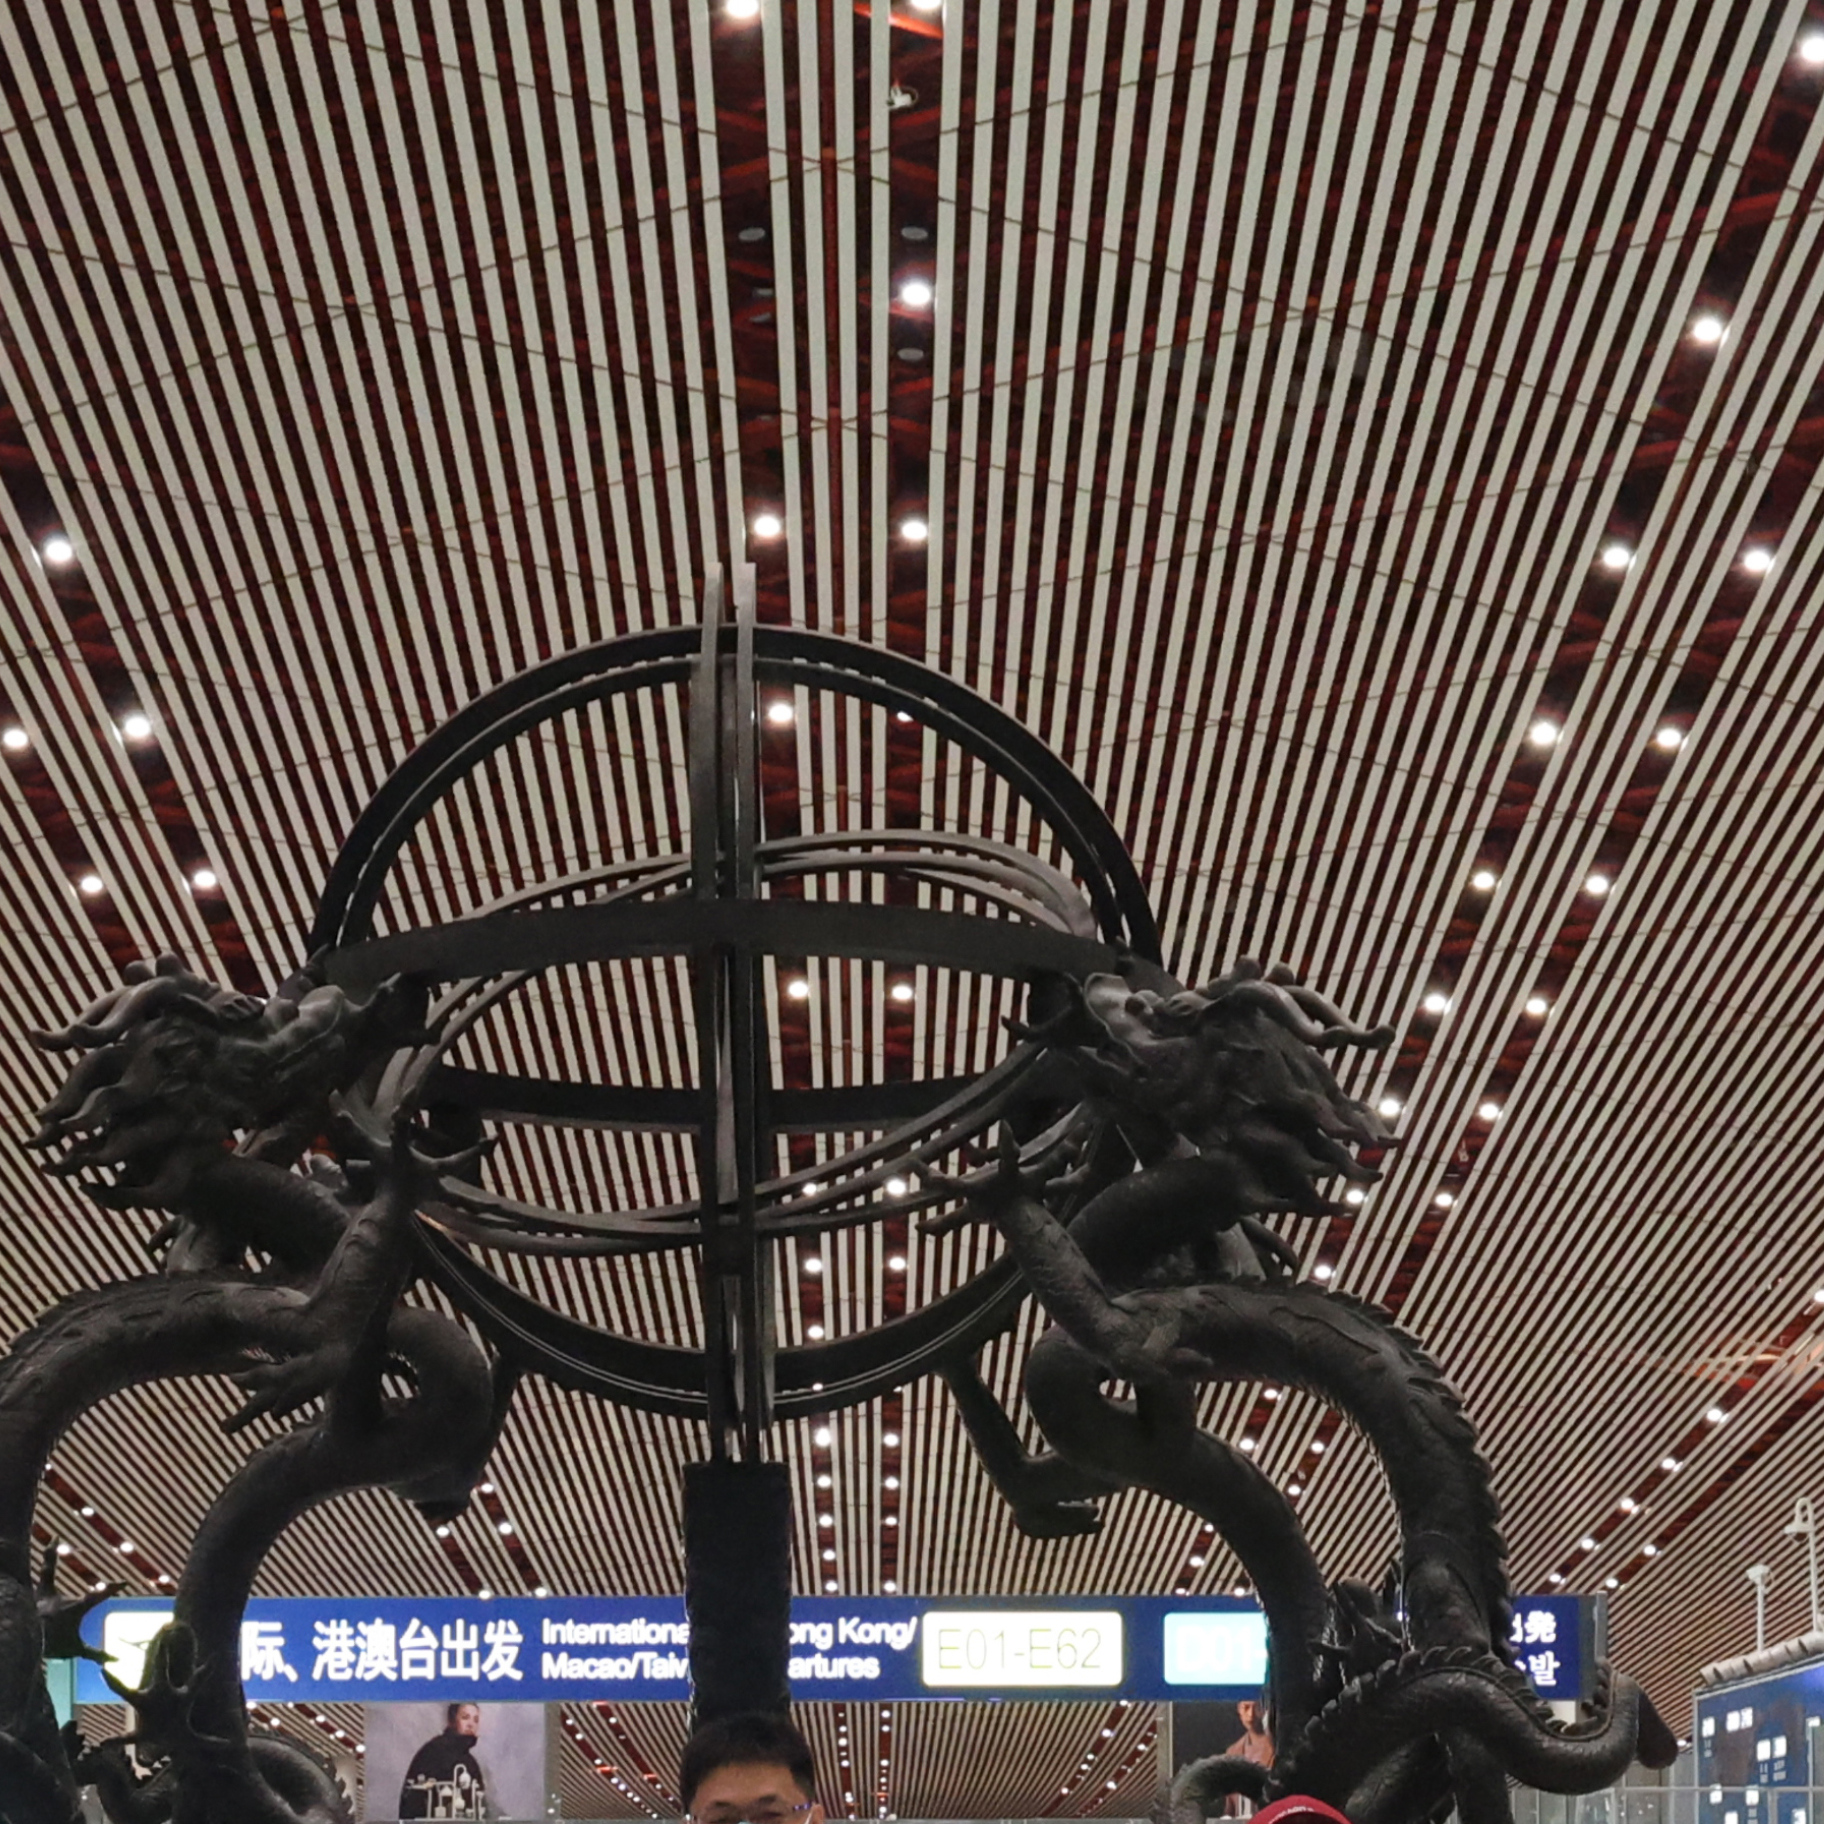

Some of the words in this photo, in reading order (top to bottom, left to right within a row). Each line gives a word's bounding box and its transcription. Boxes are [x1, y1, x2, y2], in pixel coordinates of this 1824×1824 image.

[541, 1617, 690, 1645] Internationa
[789, 1622, 833, 1650] ong
[838, 1616, 917, 1650] Kong/
[937, 1628, 1102, 1670] E01-E62
[787, 1652, 880, 1679] artures
[1514, 1650, 1560, 1686] 발
